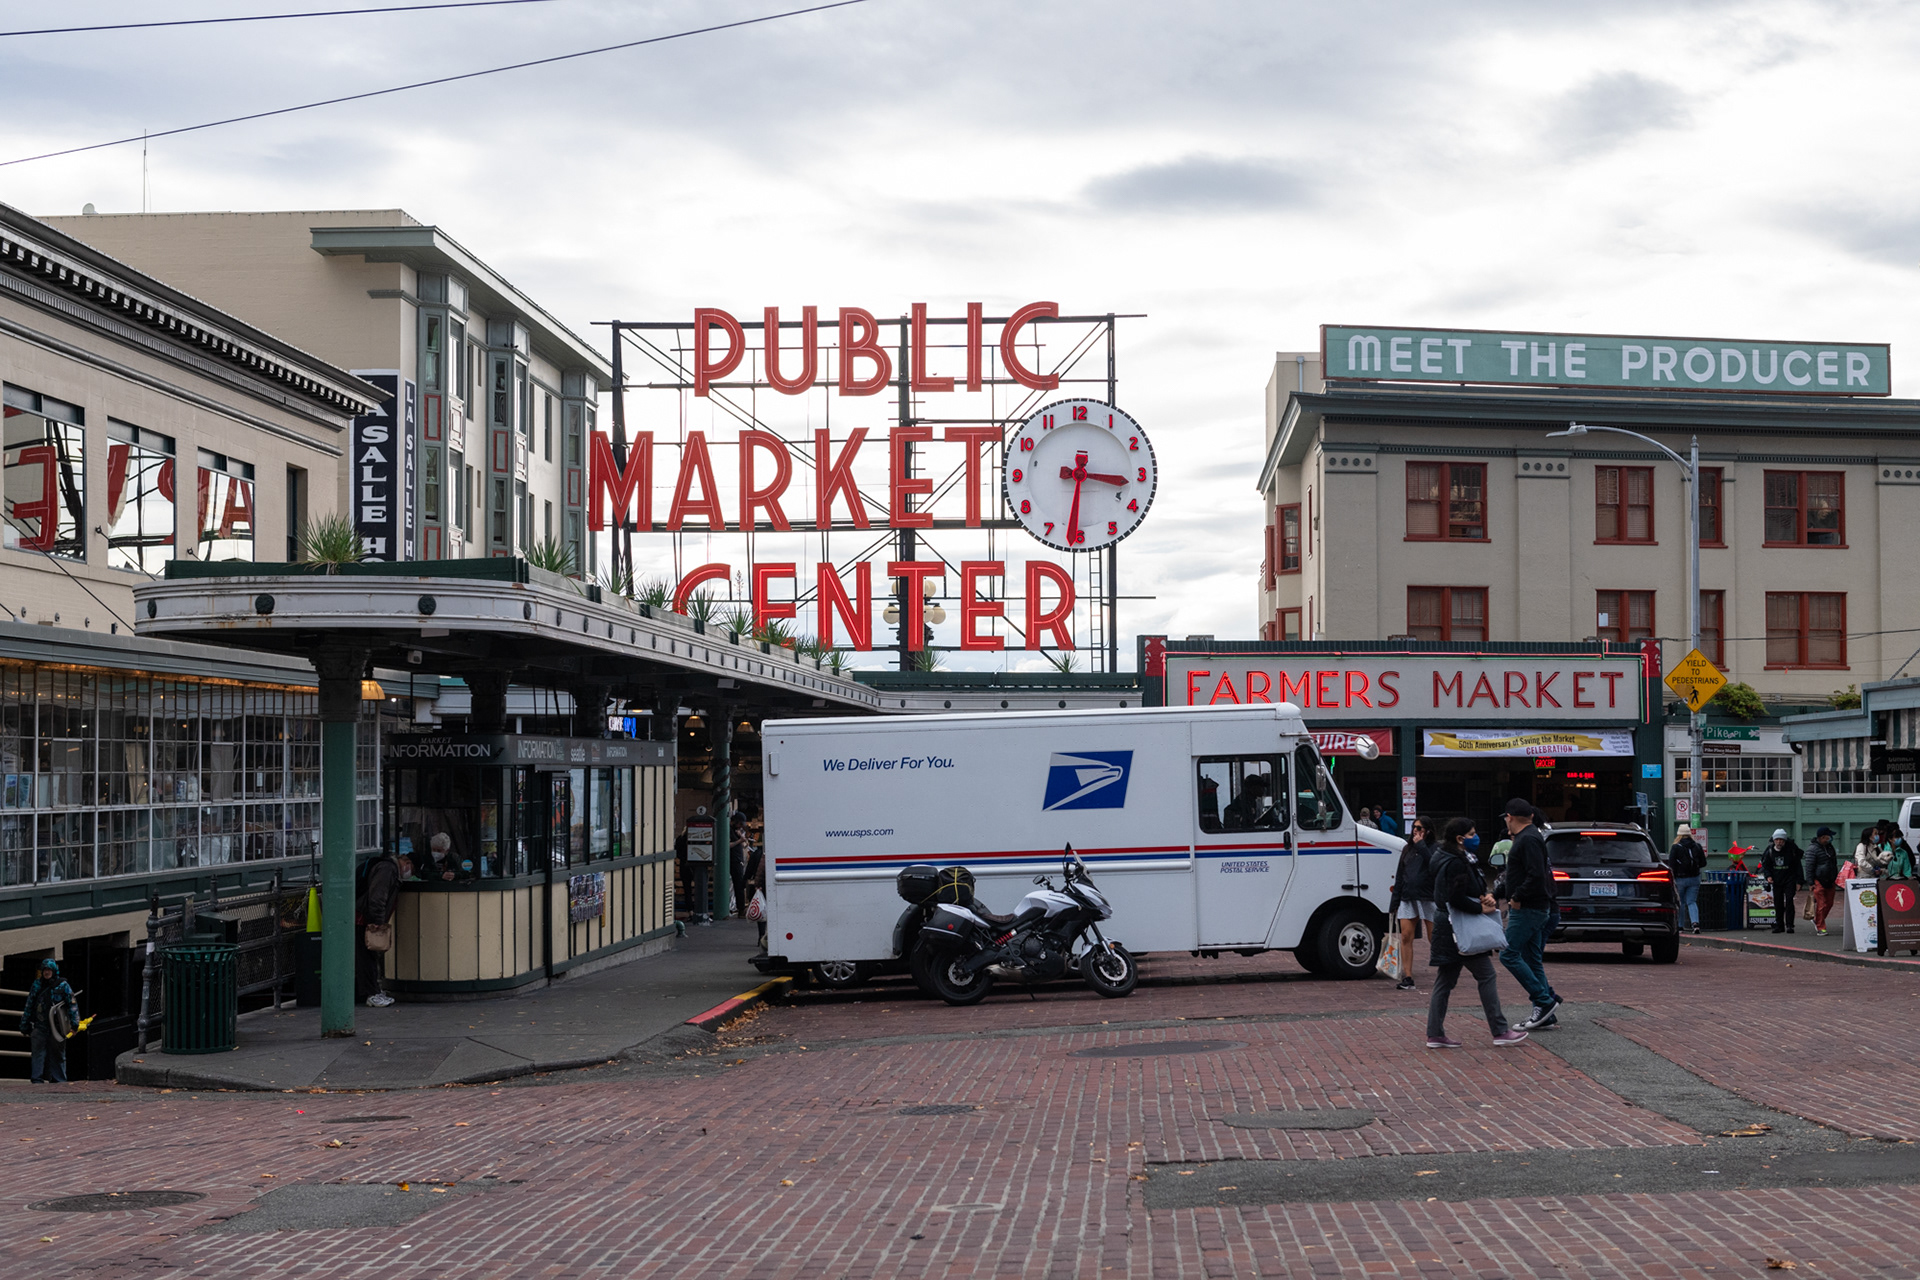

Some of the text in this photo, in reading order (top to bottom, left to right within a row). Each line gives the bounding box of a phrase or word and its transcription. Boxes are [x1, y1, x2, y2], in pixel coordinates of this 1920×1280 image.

[694, 301, 1059, 397] PUBLIC
[1348, 334, 1871, 386] MEET THE PRODUCER
[1072, 405, 1088, 421] 12
[1043, 414, 1054, 429] 11
[1108, 414, 1113, 429] 1
[1020, 437, 1034, 452] 10
[1129, 436, 1139, 451] 2
[359, 425, 389, 523] SALLE
[405, 433, 415, 529] SALLE
[589, 426, 1003, 532] MARKET
[1012, 468, 1023, 483] 9
[1137, 467, 1147, 482] 3
[1020, 499, 1031, 514] 8
[1126, 498, 1139, 513] 4
[1044, 522, 1055, 536] 7
[1107, 521, 1118, 535] 5
[1076, 529, 1085, 544] 6
[671, 560, 1076, 652] CENTER
[1671, 676, 1719, 685] PEDESTRIANS
[1187, 670, 1624, 709] FARMERS MARKET
[1706, 727, 1729, 739] Pike
[517, 739, 557, 759] INFORMATION
[1316, 733, 1371, 750] UIRE
[1458, 740, 1473, 749] 50th
[1474, 740, 1511, 749] Anniversary
[1519, 737, 1541, 745] Saving
[1541, 735, 1552, 743] the
[1553, 734, 1576, 743] Market
[390, 744, 491, 758] INFORMATION
[1525, 745, 1573, 755] CELEBRATION
[823, 756, 955, 771] We Deliver For You.
[1887, 763, 1916, 772] PRODUCE
[825, 828, 894, 838] www.usps.com
